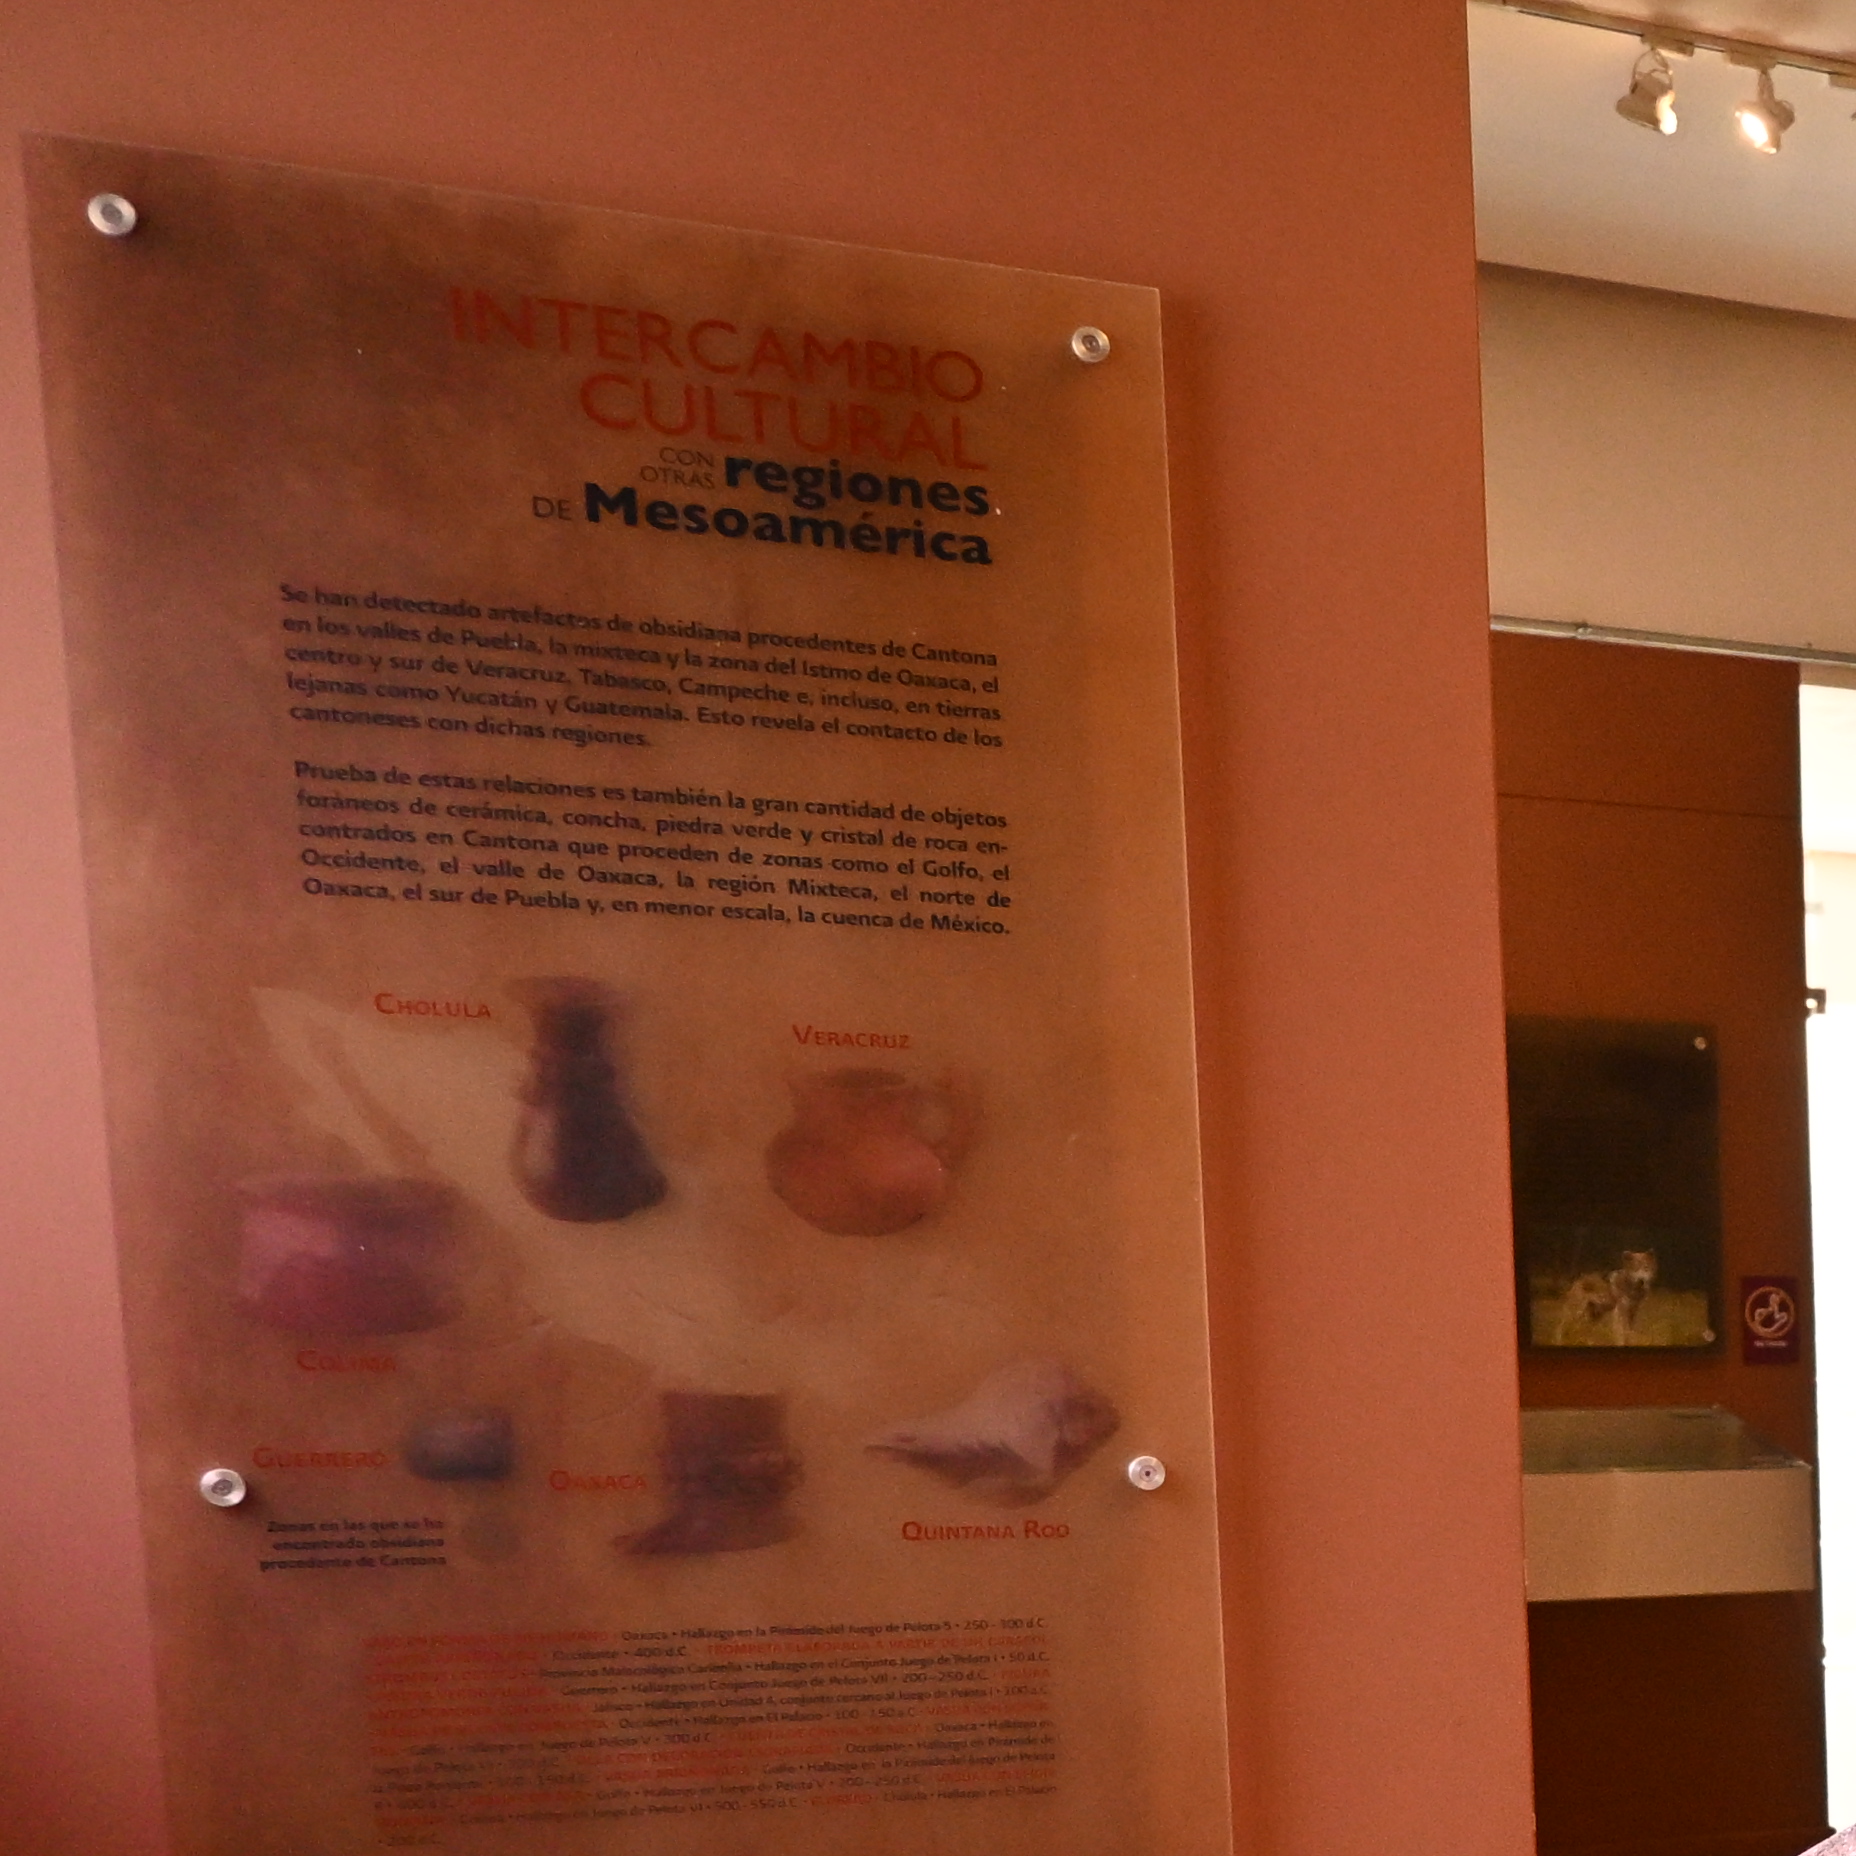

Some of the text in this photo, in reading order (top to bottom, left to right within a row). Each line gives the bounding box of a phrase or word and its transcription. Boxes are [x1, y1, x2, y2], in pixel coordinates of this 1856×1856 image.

[450, 286, 984, 403] INTERCAMBIO
[581, 373, 989, 472] CULTURAL
[641, 465, 715, 490] OTRAS
[659, 446, 715, 468] CON
[724, 454, 990, 518] regiones
[532, 482, 993, 565] DE Mesoamérica
[281, 582, 997, 667] Se han detectado artefactos de obsidiana procedentes de Cantona
[283, 616, 999, 694] en los valles de Puebla, la mixteca y la zona del Istmo de Oaxaca, el
[285, 648, 1001, 721] centro y sur de Veracruz, Tabasco, Campeche e, incluso, en tierras
[287, 672, 1002, 747] lejanas como Yucatán y Guatemala. Esto revela el contacto de los
[290, 704, 650, 748] cantoneses con dichas regiones.
[295, 761, 1007, 830] Prueba de estas relaciones es también la gran cantidad de objetos
[298, 789, 1008, 854] foráneos de cerámica, concha, piedra verde y cristal de roca en-
[299, 822, 1010, 881] contrados en Cantona que proceden de zonas como el Golfo, el
[302, 848, 1011, 908] Occidente, el valle de Oaxaca, la región Mixteca, el norte de
[304, 877, 1010, 935] Oaxaca, el sur de Puebla y, en menor escala, la cuenca de México.
